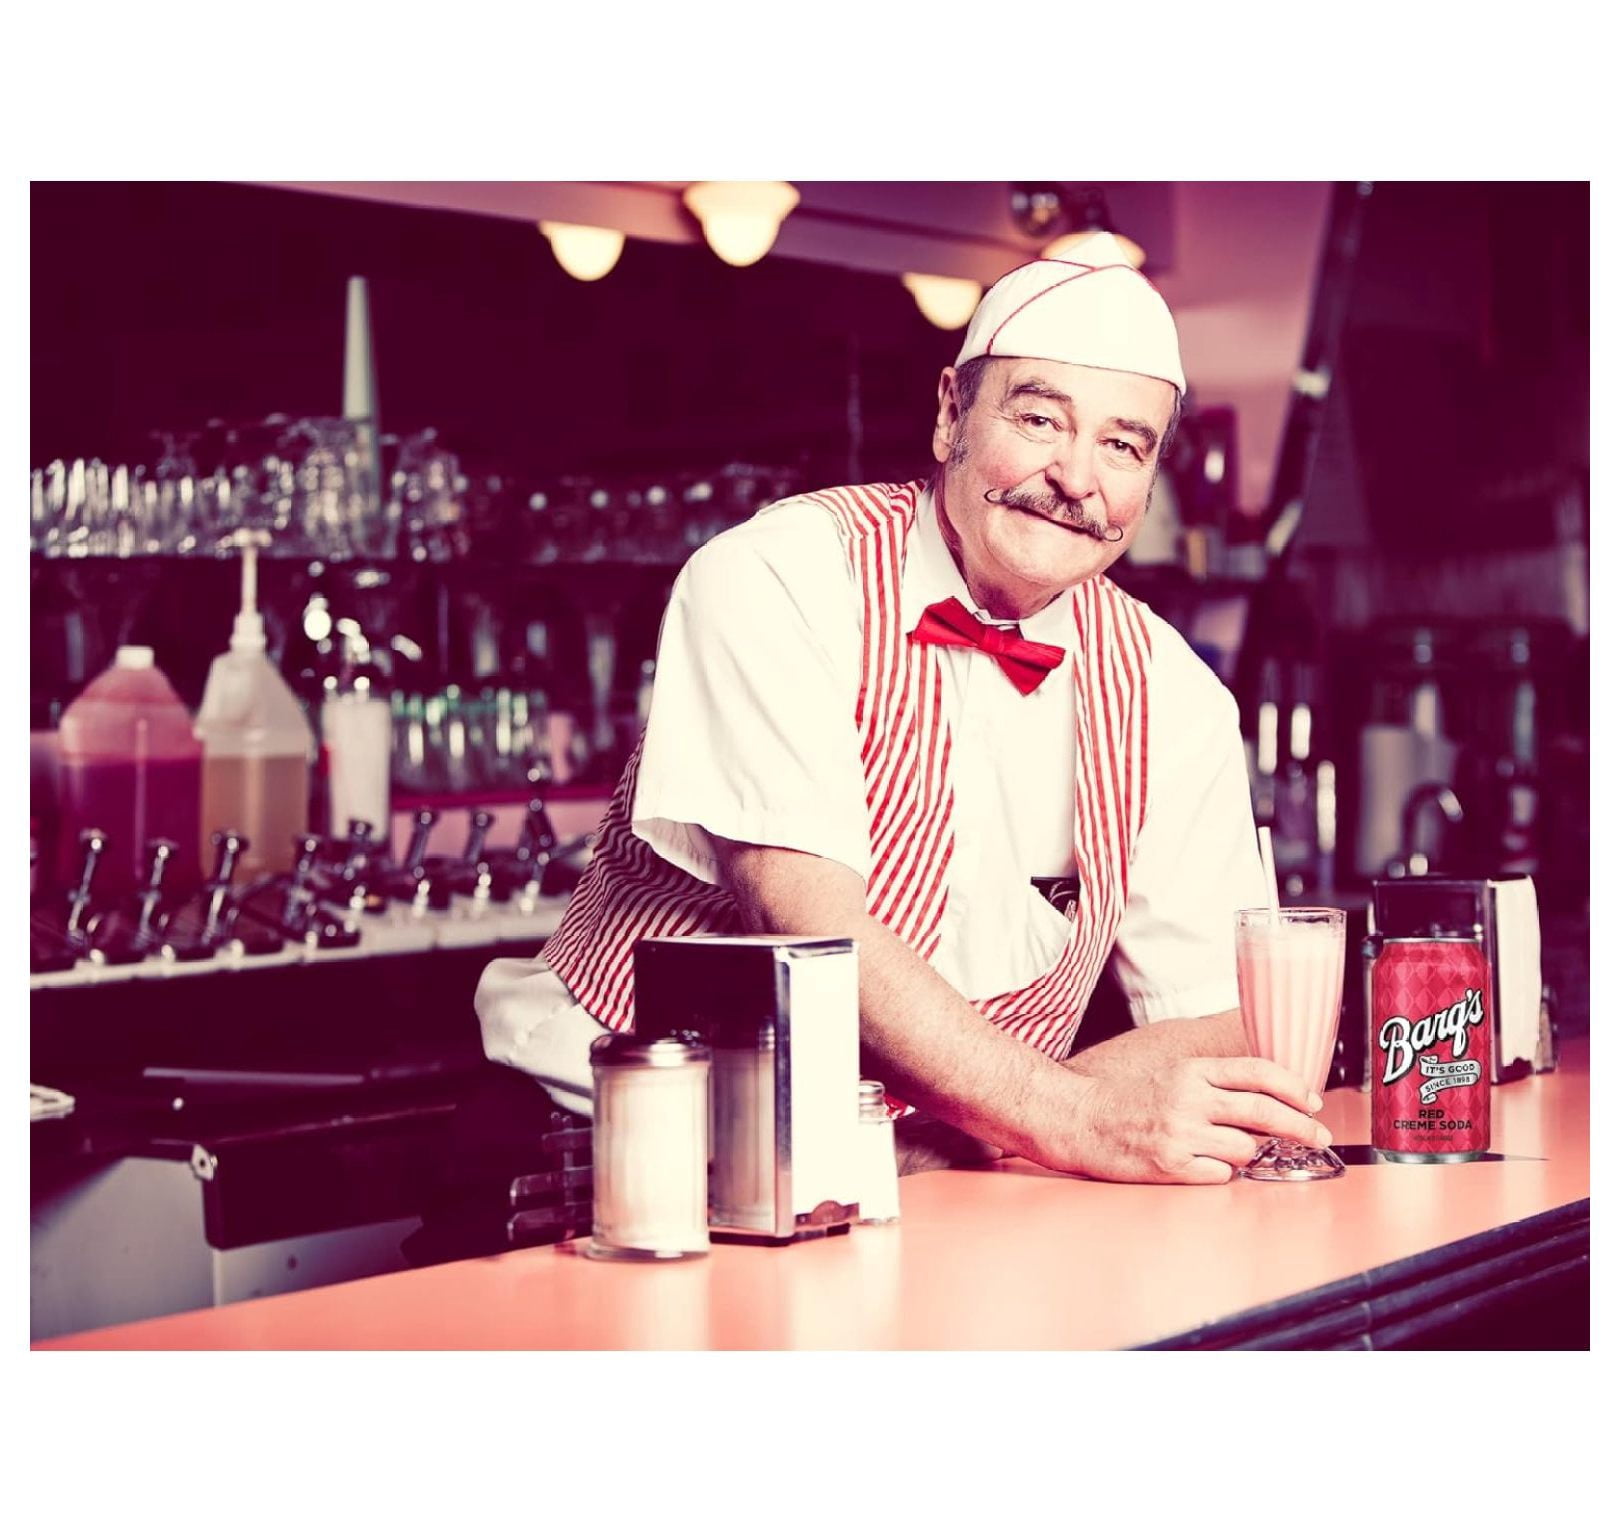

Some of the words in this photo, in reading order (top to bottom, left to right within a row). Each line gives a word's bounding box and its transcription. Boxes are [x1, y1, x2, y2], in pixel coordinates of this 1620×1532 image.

[1380, 989, 1484, 1085] Barq's
[1425, 1065, 1446, 1075] IT'S
[1448, 1063, 1476, 1074] GOOD
[1425, 1077, 1451, 1093] SINCE
[1418, 1109, 1445, 1119] RED
[1393, 1119, 1436, 1130] CREME
[1439, 1119, 1473, 1130] SODA
